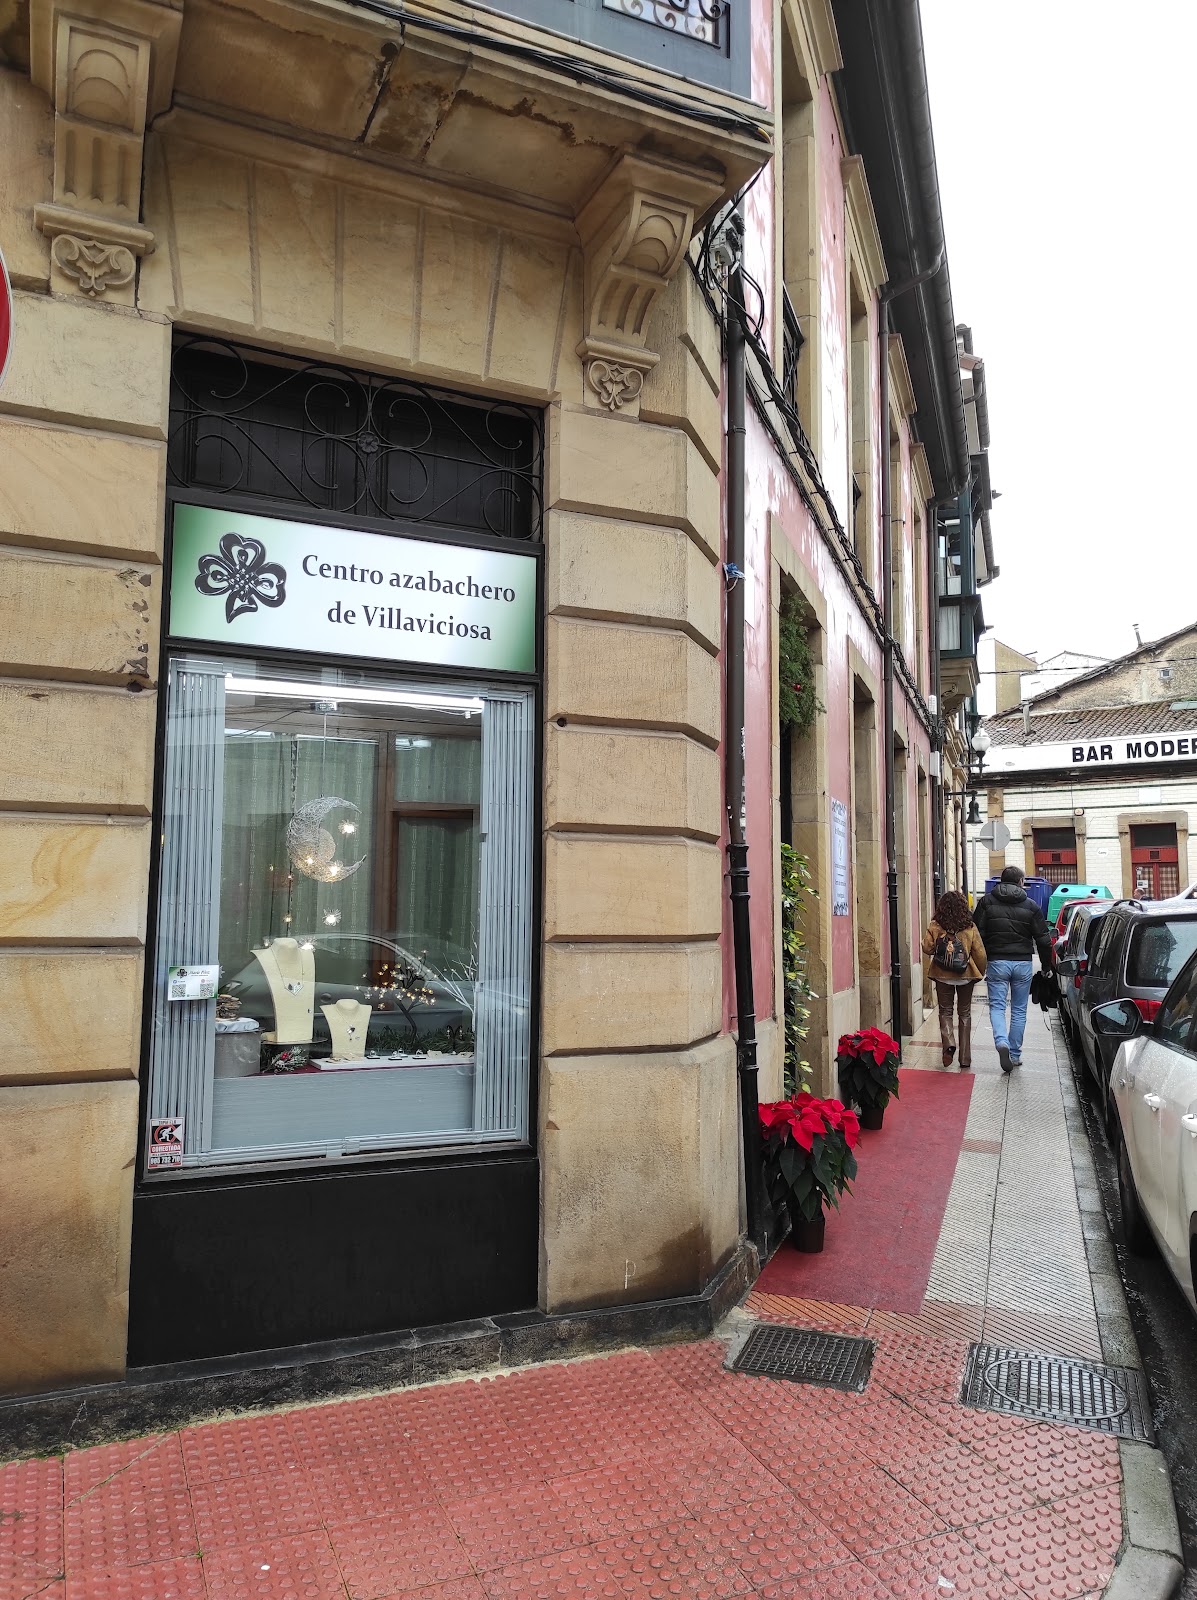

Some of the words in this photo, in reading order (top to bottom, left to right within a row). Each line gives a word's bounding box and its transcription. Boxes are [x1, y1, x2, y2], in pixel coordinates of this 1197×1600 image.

[302, 553, 384, 586] Centro
[389, 570, 516, 603] azabachero
[327, 601, 356, 625] de
[361, 604, 493, 641] Villaviciosa
[1072, 744, 1113, 763] BAR
